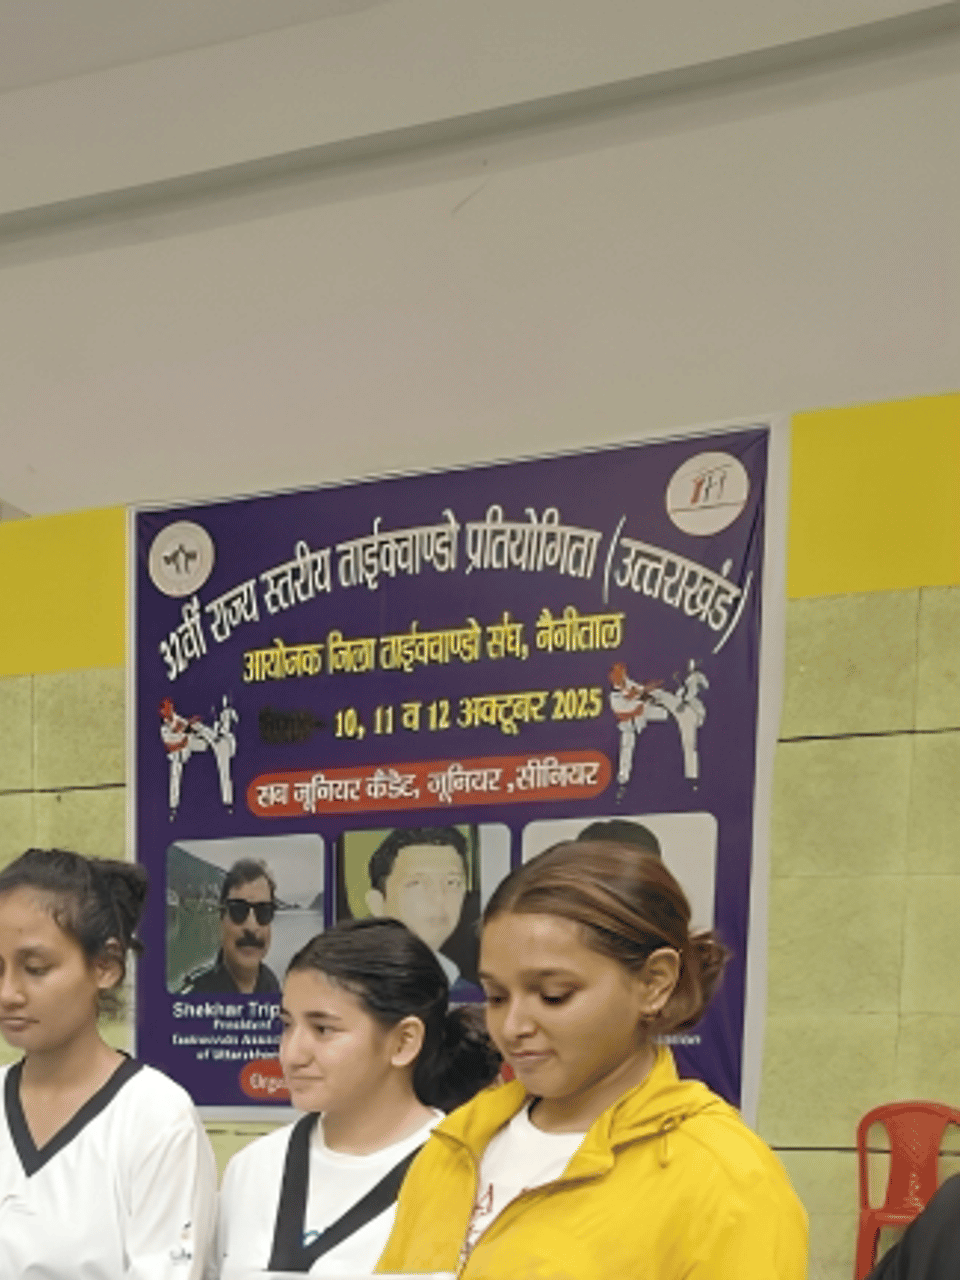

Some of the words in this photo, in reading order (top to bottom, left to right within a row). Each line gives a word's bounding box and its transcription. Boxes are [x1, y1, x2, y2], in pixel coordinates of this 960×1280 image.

[205, 578, 259, 643] राज्य
[259, 540, 331, 614] स्तरीय
[465, 504, 602, 578] प्रतियोगिता
[536, 605, 625, 653] नैनीताल
[334, 706, 366, 740] 10,
[374, 705, 394, 735] 11
[401, 702, 423, 732] व
[428, 699, 450, 731] 12
[457, 691, 549, 735] अक्टूबर
[551, 688, 603, 720] 2025
[256, 783, 289, 807] सब
[294, 773, 362, 813] जूनियर
[172, 1001, 244, 1018] Shekhar
[248, 1001, 280, 1020] Trip
